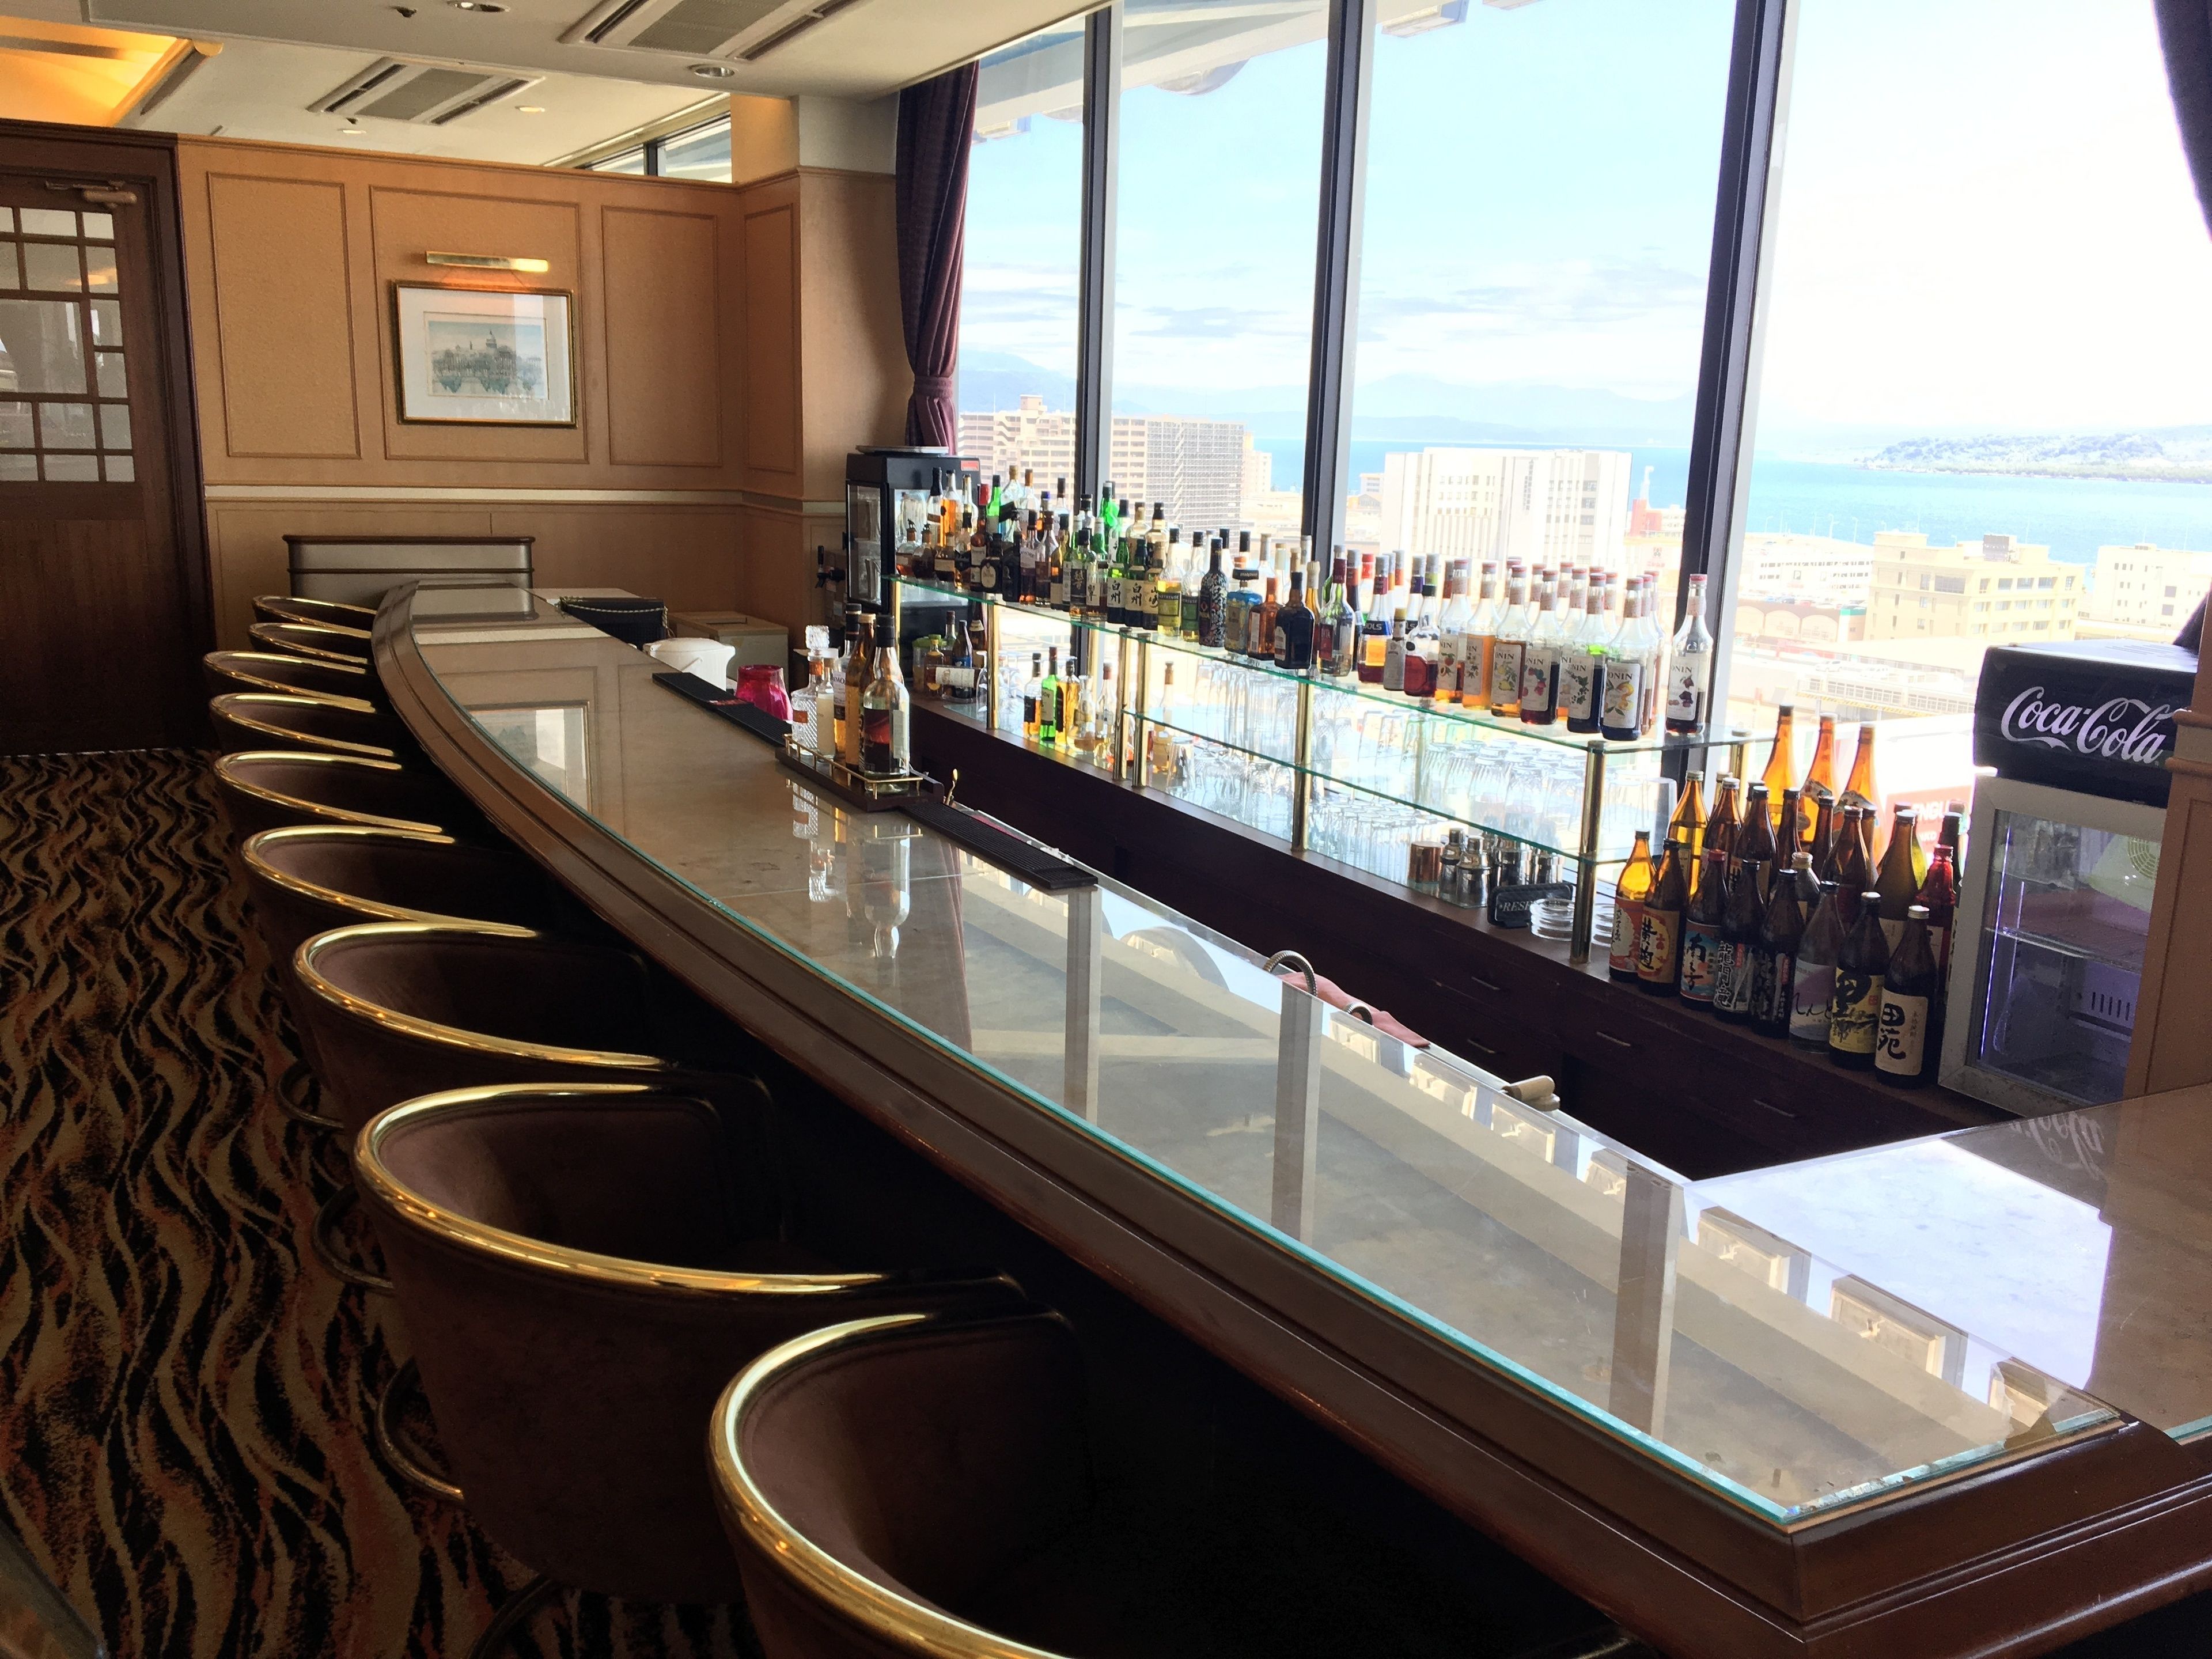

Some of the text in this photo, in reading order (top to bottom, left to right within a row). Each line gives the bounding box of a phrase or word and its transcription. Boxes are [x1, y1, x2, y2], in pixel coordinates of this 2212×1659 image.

[1111, 579, 1121, 604] 白州
[1131, 582, 1142, 607] 白州
[2001, 686, 2175, 764] Coca-Cola
[1877, 1002, 1906, 1059] 田苑
